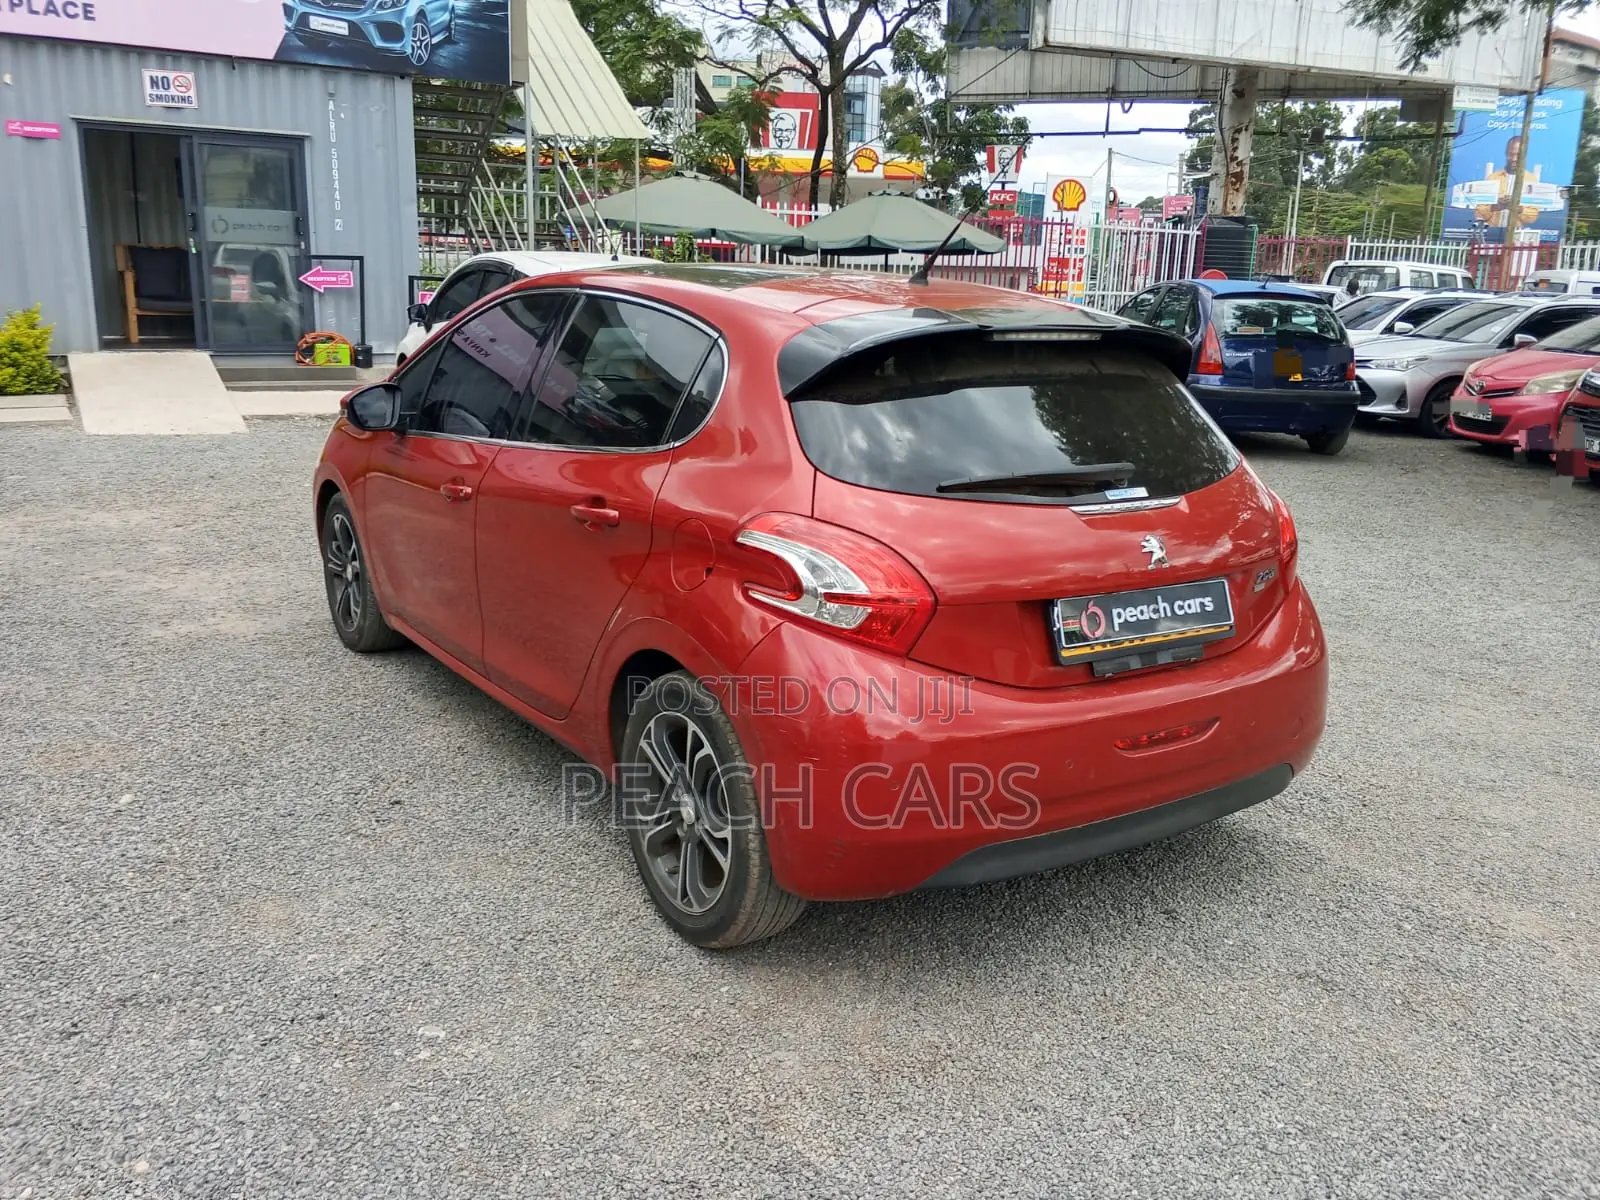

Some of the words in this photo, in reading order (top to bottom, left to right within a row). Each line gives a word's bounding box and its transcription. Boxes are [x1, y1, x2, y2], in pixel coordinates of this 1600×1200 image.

[0, 0, 96, 21] PLACE
[149, 75, 170, 90] NO
[148, 93, 193, 105] SMOKING
[331, 148, 341, 211] 509440
[992, 193, 1014, 201] KFC
[1112, 595, 1172, 632] peach
[1173, 596, 1214, 616] cars
